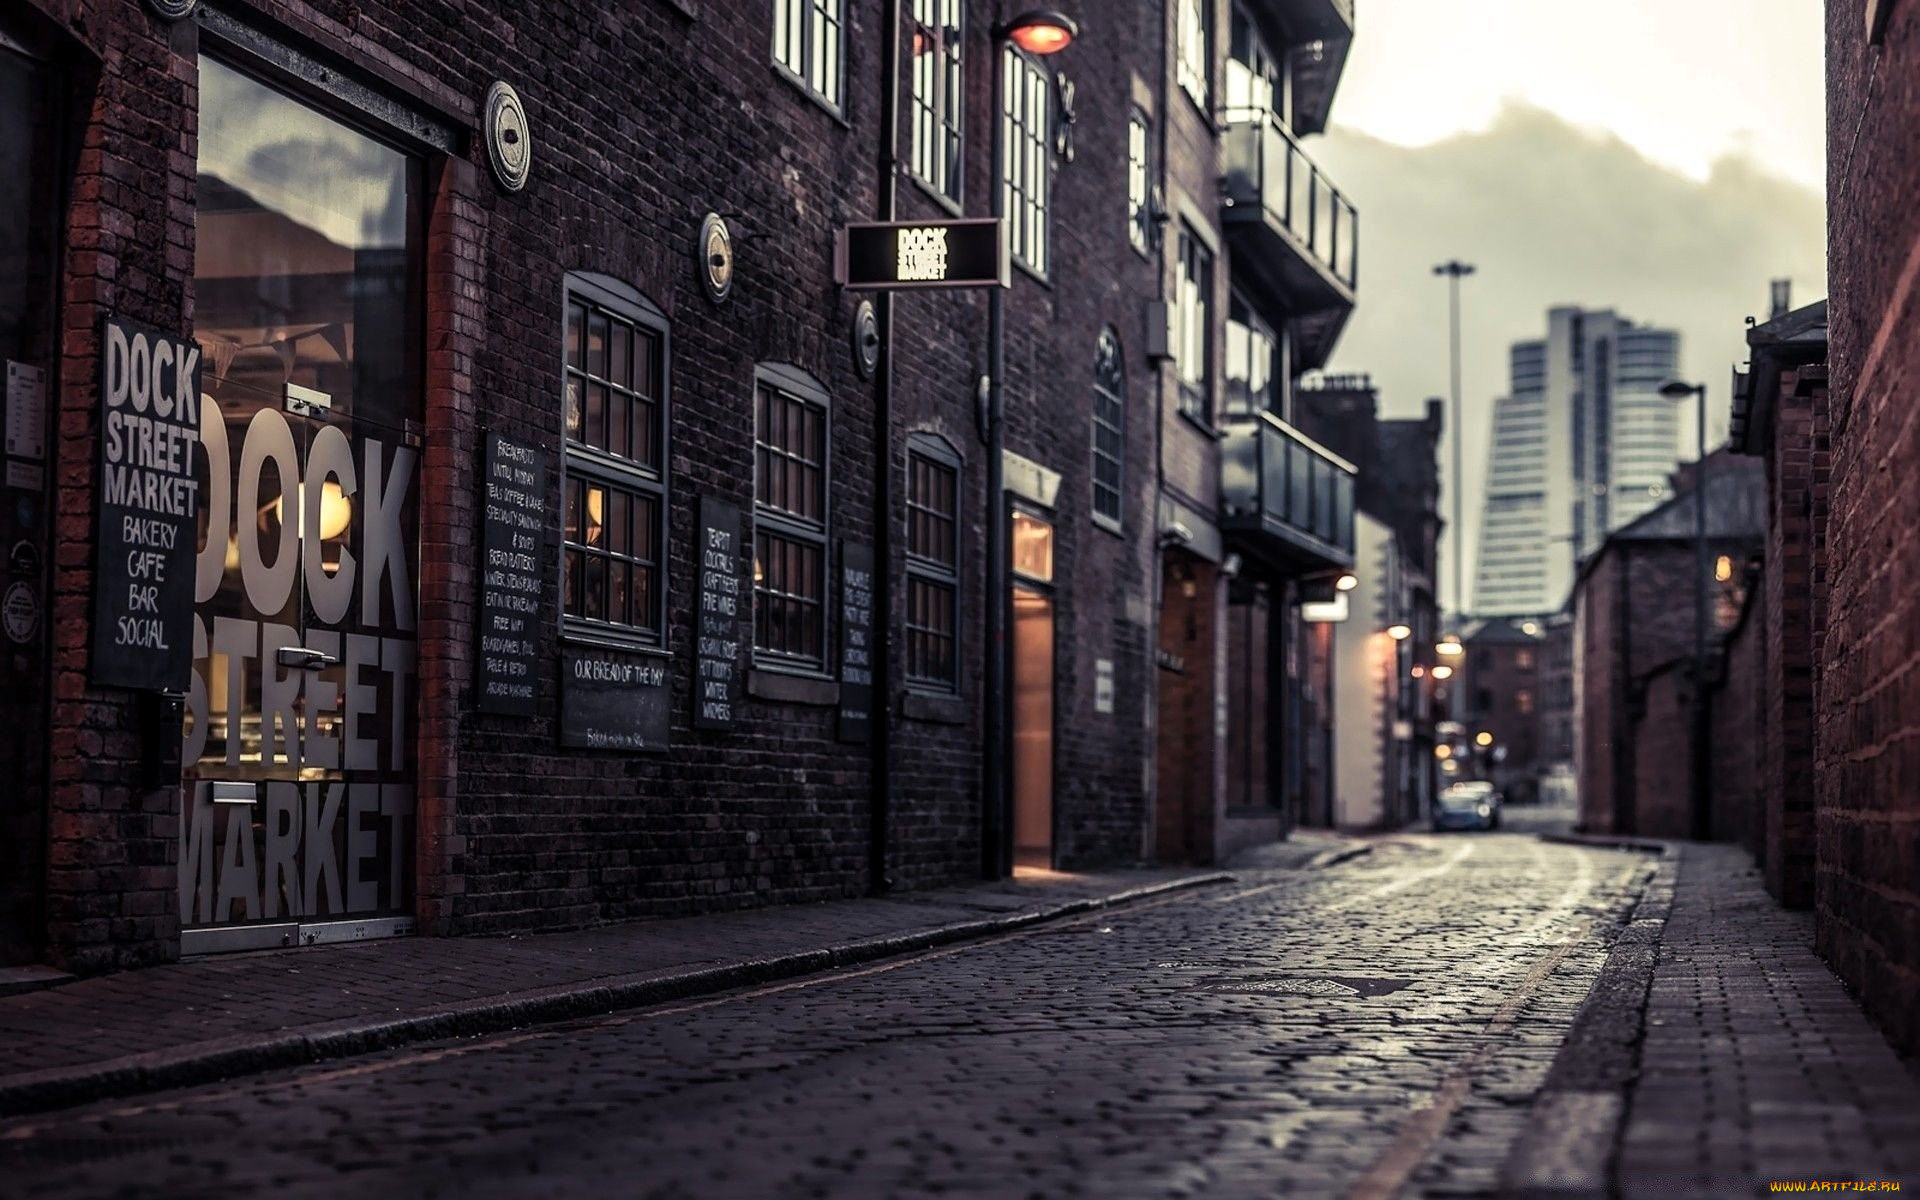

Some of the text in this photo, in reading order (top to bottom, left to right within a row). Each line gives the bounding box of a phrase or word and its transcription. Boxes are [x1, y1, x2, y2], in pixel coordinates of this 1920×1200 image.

[897, 228, 948, 251] DOCK
[107, 323, 199, 424] DOCK
[106, 409, 198, 476] STREET
[105, 463, 198, 517] MARKET
[486, 482, 503, 500] TEAS
[504, 487, 525, 507] COFFEE
[123, 515, 178, 550] BAKERY
[127, 549, 166, 582] CAFE
[489, 548, 509, 567] BREAD
[128, 583, 160, 613] BAR
[485, 591, 498, 608] EAT
[115, 615, 169, 650] SOCIAL
[493, 615, 509, 631] FREE
[575, 659, 664, 687] OUR BREAD OF THE DAY
[179, 780, 418, 925] MARKET
